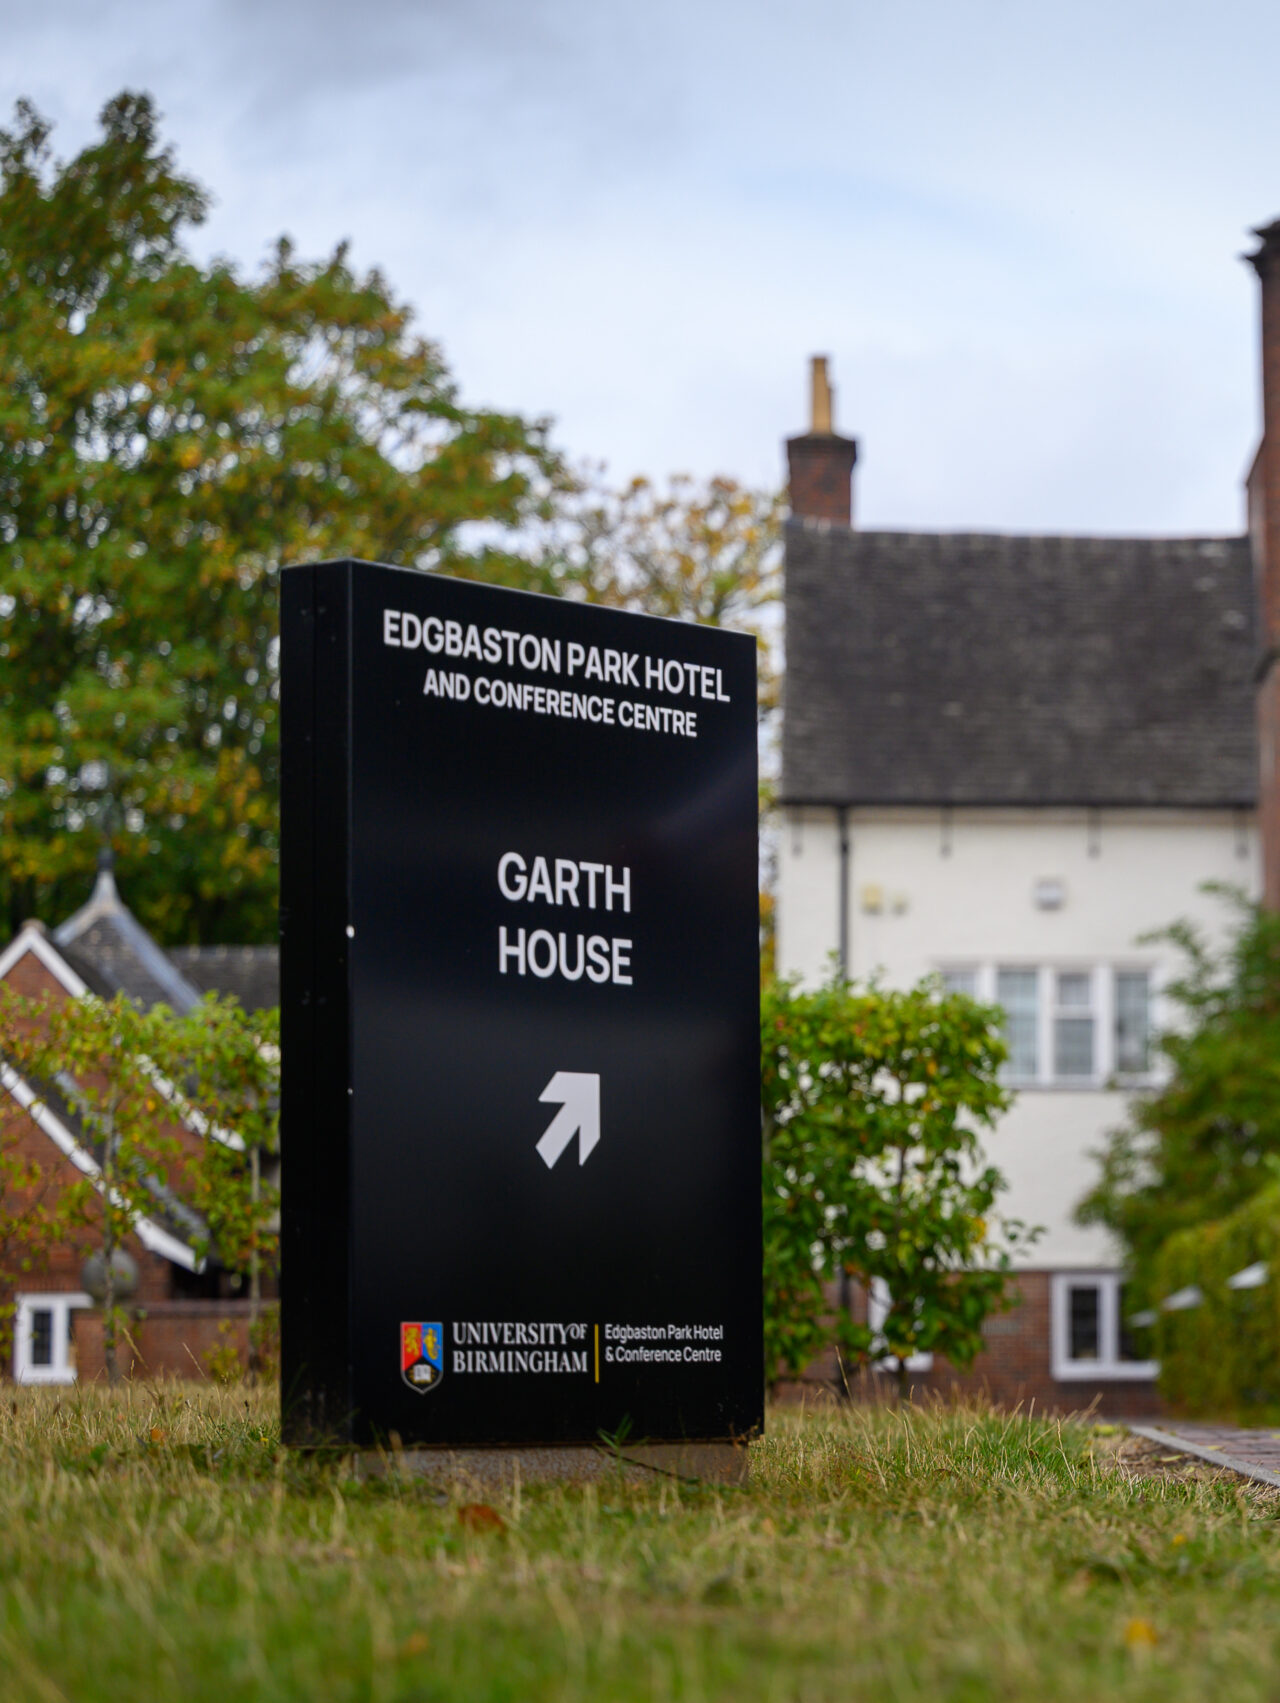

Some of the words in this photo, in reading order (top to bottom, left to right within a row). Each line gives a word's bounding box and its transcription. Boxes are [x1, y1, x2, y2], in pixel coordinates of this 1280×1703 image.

[383, 609, 561, 674] EDGBASTON
[567, 643, 640, 688] PARK
[645, 656, 731, 703] HOTEL
[423, 668, 471, 701] AND
[474, 676, 615, 725] CONFERENCE
[618, 701, 698, 738] CENTRE
[498, 852, 631, 912] GARTH
[499, 926, 633, 985] HOUSE
[452, 1322, 571, 1345] UNIVERSITY
[604, 1323, 667, 1344] Edgbaston
[668, 1324, 693, 1340] Park
[694, 1324, 724, 1340] Hotel
[605, 1346, 615, 1362] &
[615, 1346, 682, 1362] Conference
[683, 1346, 722, 1362] Centre
[452, 1350, 588, 1373] BIRMINGHAM
